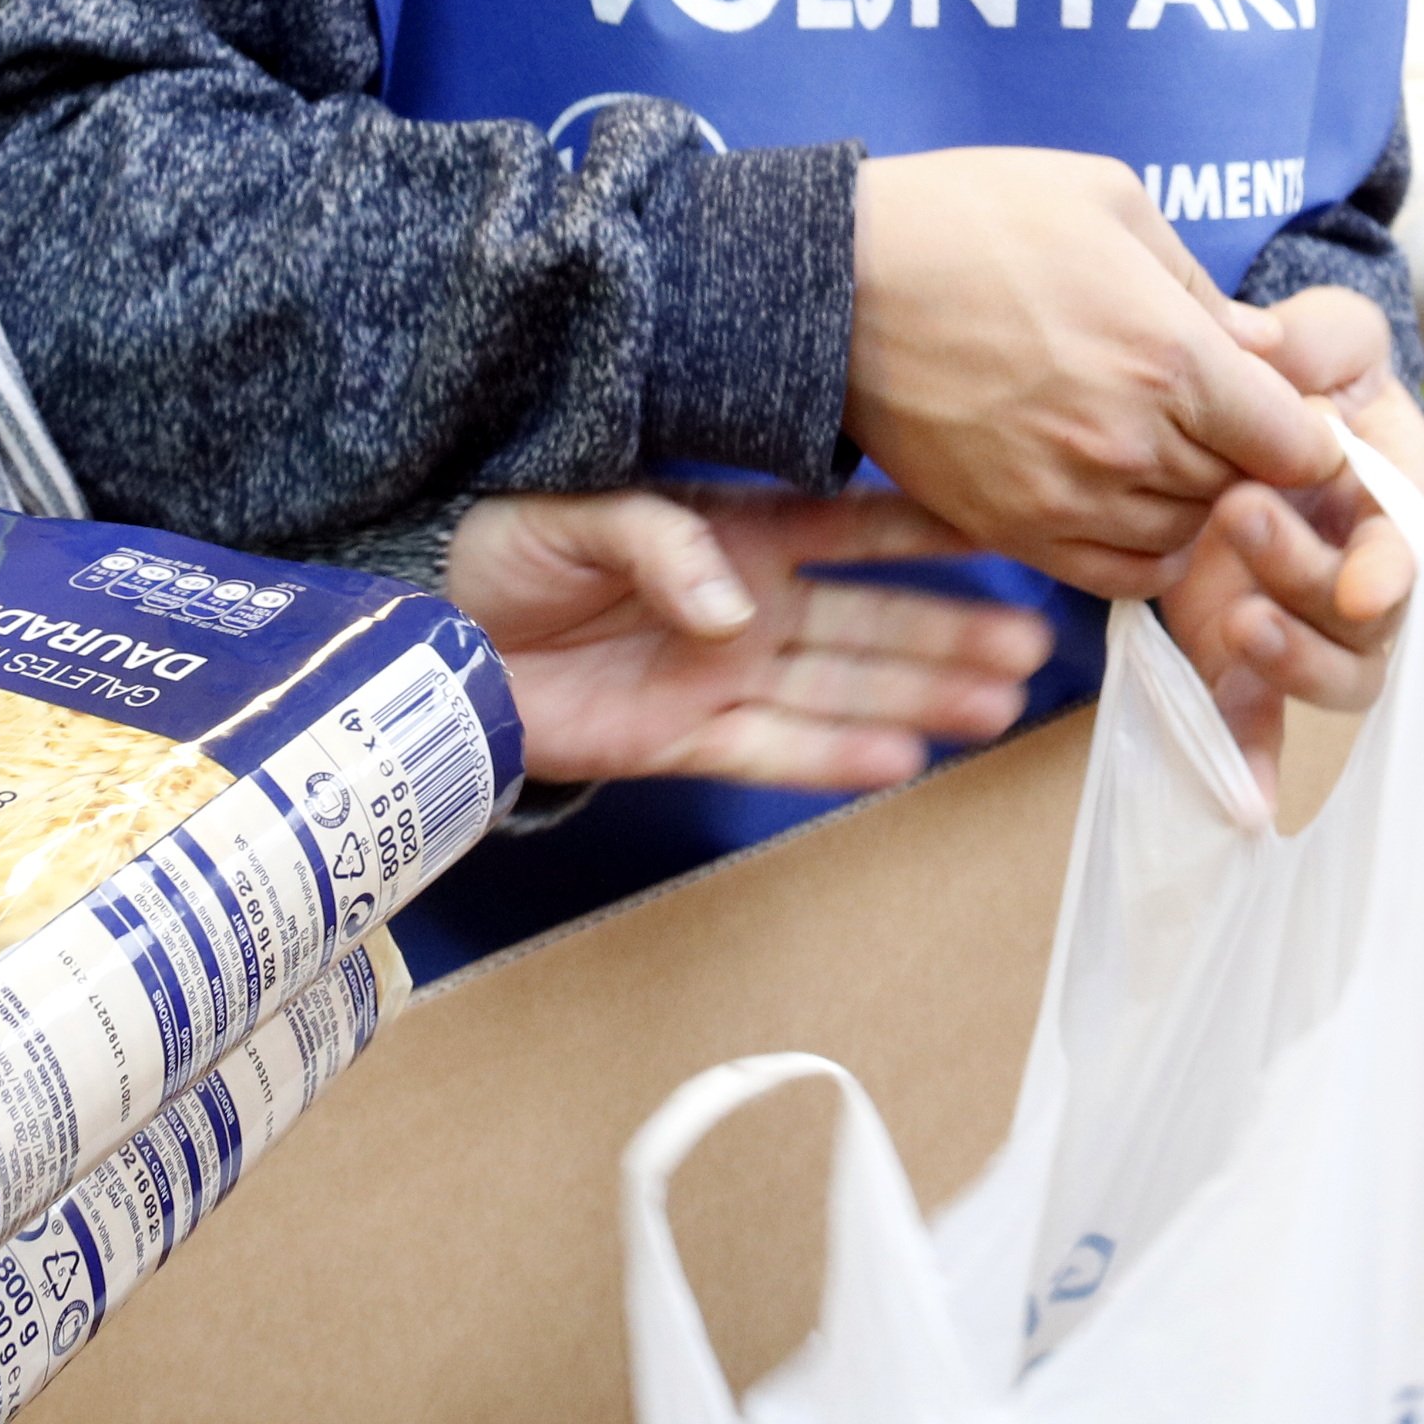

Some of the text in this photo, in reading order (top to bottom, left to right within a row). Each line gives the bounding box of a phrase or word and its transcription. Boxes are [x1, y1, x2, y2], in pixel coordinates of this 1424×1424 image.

[5, 654, 159, 706] GALETES
[340, 709, 420, 865] (200 g x 4)
[371, 795, 390, 818] g
[232, 832, 249, 850] SA
[357, 838, 371, 855] PP
[378, 826, 399, 881] 800
[341, 855, 353, 865] 5
[177, 879, 189, 890] la
[292, 860, 314, 903] Voltregà
[133, 892, 150, 912] cop
[151, 893, 172, 917] cada
[263, 885, 286, 927] Galletas
[304, 902, 318, 917] de
[168, 918, 181, 933] de
[197, 905, 218, 937] abans
[230, 868, 276, 990] 902 16 09 25
[287, 914, 298, 936] SAU
[230, 911, 255, 959] CLIENT
[277, 927, 291, 944] per
[295, 926, 311, 942] 73
[175, 933, 202, 975] després
[244, 957, 259, 975] AL
[355, 949, 370, 978] ARIA
[175, 956, 192, 984] fresc
[212, 937, 238, 1008] preferentment
[235, 967, 246, 996] vegeu
[210, 975, 224, 1030] CONSUM
[32, 1027, 45, 1043] de
[22, 1039, 40, 1062] ens
[42, 1043, 73, 1109] necessària
[0, 1088, 13, 1104] de
[10, 1082, 28, 1101] llet
[35, 1062, 62, 1119] daurades
[206, 1072, 236, 1125] NACIONS
[7, 1104, 20, 1120] ml
[20, 1101, 33, 1117] ml
[23, 1068, 57, 1154] cereals galetes
[174, 1097, 200, 1139] nqueu-lo
[13, 1120, 27, 1145] 200
[26, 1118, 41, 1142] 200
[55, 1118, 68, 1153] maria
[66, 1110, 81, 1157] quantitat
[154, 1116, 188, 1178] referentment
[129, 1166, 152, 1195] 16
[140, 1144, 169, 1202] AL CLIENT
[105, 1185, 122, 1208] SAU
[139, 1193, 160, 1219] 09
[89, 1207, 103, 1223] de
[122, 1194, 141, 1233] Galletas
[95, 1220, 113, 1262] Voltregà
[148, 1218, 162, 1242] 25
[57, 1267, 69, 1277] 5
[39, 1280, 55, 1298] PP
[19, 1321, 39, 1346] g
